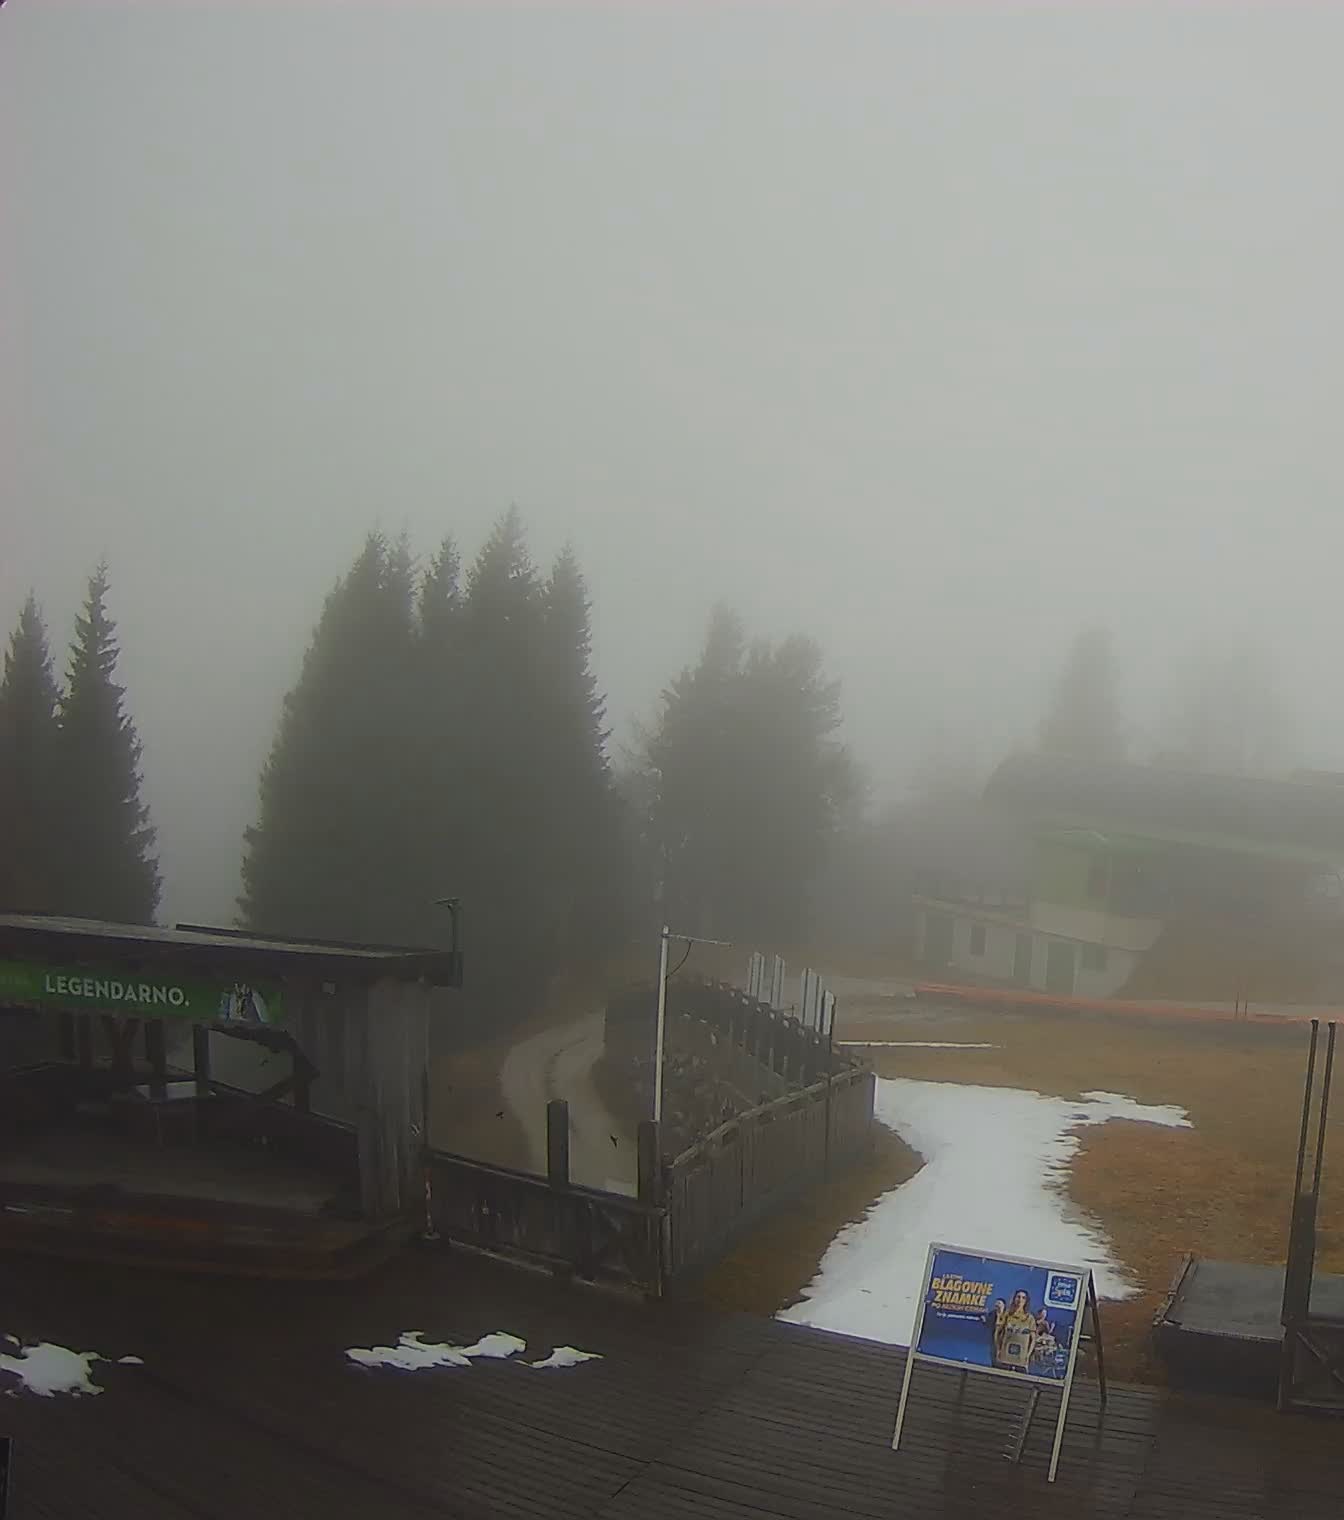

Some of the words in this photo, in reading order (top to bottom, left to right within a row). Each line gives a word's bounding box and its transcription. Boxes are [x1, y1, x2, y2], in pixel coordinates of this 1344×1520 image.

[45, 975, 190, 1007] LEGENDARNO.
[931, 1277, 993, 1296] BLAGOVNE
[934, 1290, 987, 1307] ZNAMKE
